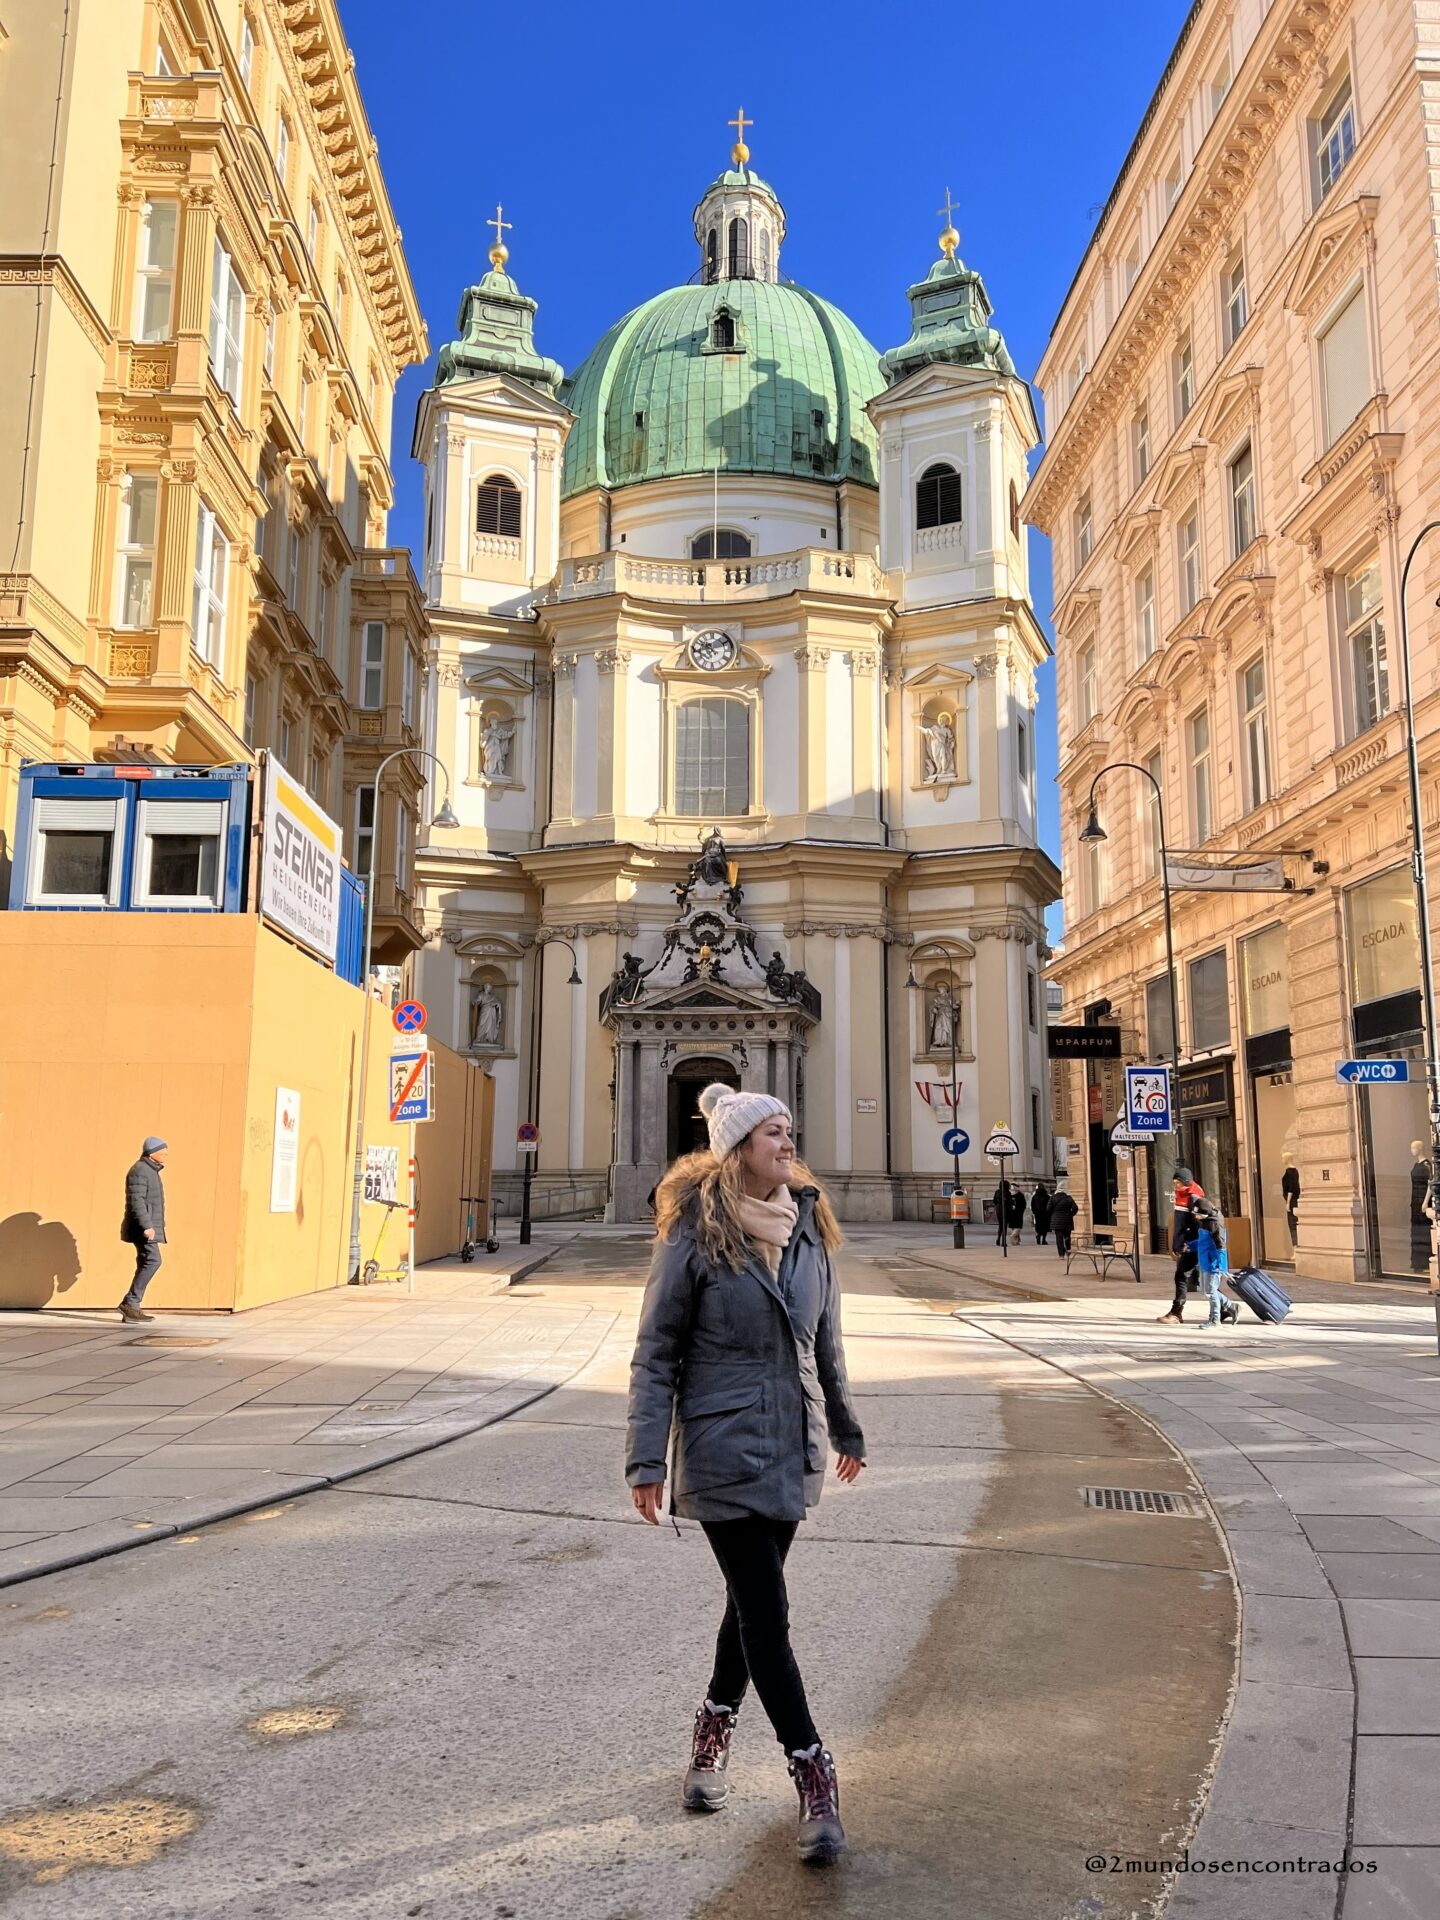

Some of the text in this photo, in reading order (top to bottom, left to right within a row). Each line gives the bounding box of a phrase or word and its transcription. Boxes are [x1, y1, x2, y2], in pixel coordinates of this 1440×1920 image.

[274, 811, 334, 903] STEINER
[272, 862, 333, 923] HEILIGENEICH
[272, 886, 283, 911] Wir
[281, 897, 298, 924] bauen
[297, 909, 308, 931] Ihre
[1361, 921, 1406, 949] ESCADA
[1251, 970, 1282, 991] ESCADA
[1356, 1064, 1381, 1078] WC
[411, 1085, 424, 1098] 20
[397, 1105, 422, 1115] Zone
[1151, 1098, 1164, 1110] 20
[1137, 1115, 1163, 1125] Zone
